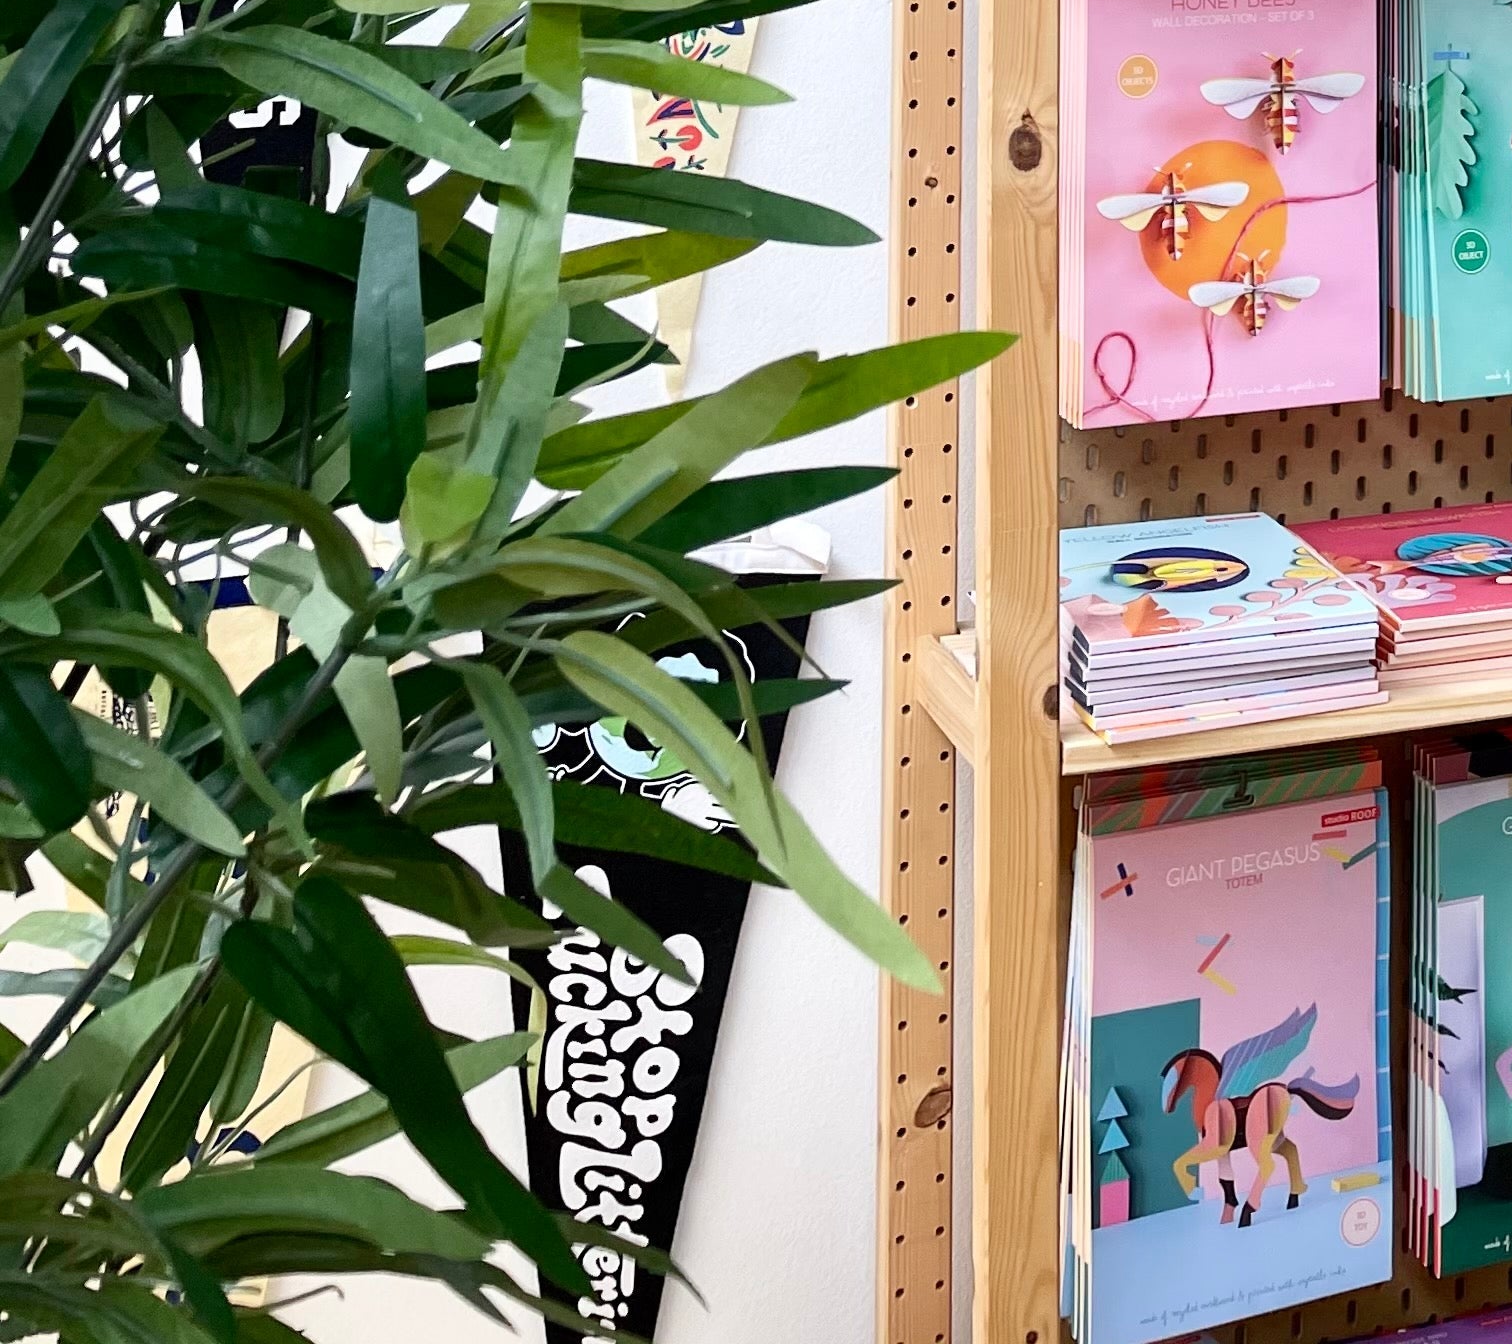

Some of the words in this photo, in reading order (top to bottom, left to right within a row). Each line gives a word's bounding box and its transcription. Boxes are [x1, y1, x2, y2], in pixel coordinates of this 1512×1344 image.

[1152, 15, 1182, 28] WALL
[1184, 12, 1258, 27] DECORATION
[1268, 12, 1288, 23] SET
[1289, 11, 1304, 22] OF
[1306, 10, 1315, 21] 3
[1324, 814, 1350, 826] studio
[1351, 808, 1377, 822] ROOF
[1165, 859, 1226, 888] GIANT
[1231, 841, 1321, 876] PEGASUS
[1225, 873, 1263, 890] TOTEM
[610, 933, 704, 1137] Stop
